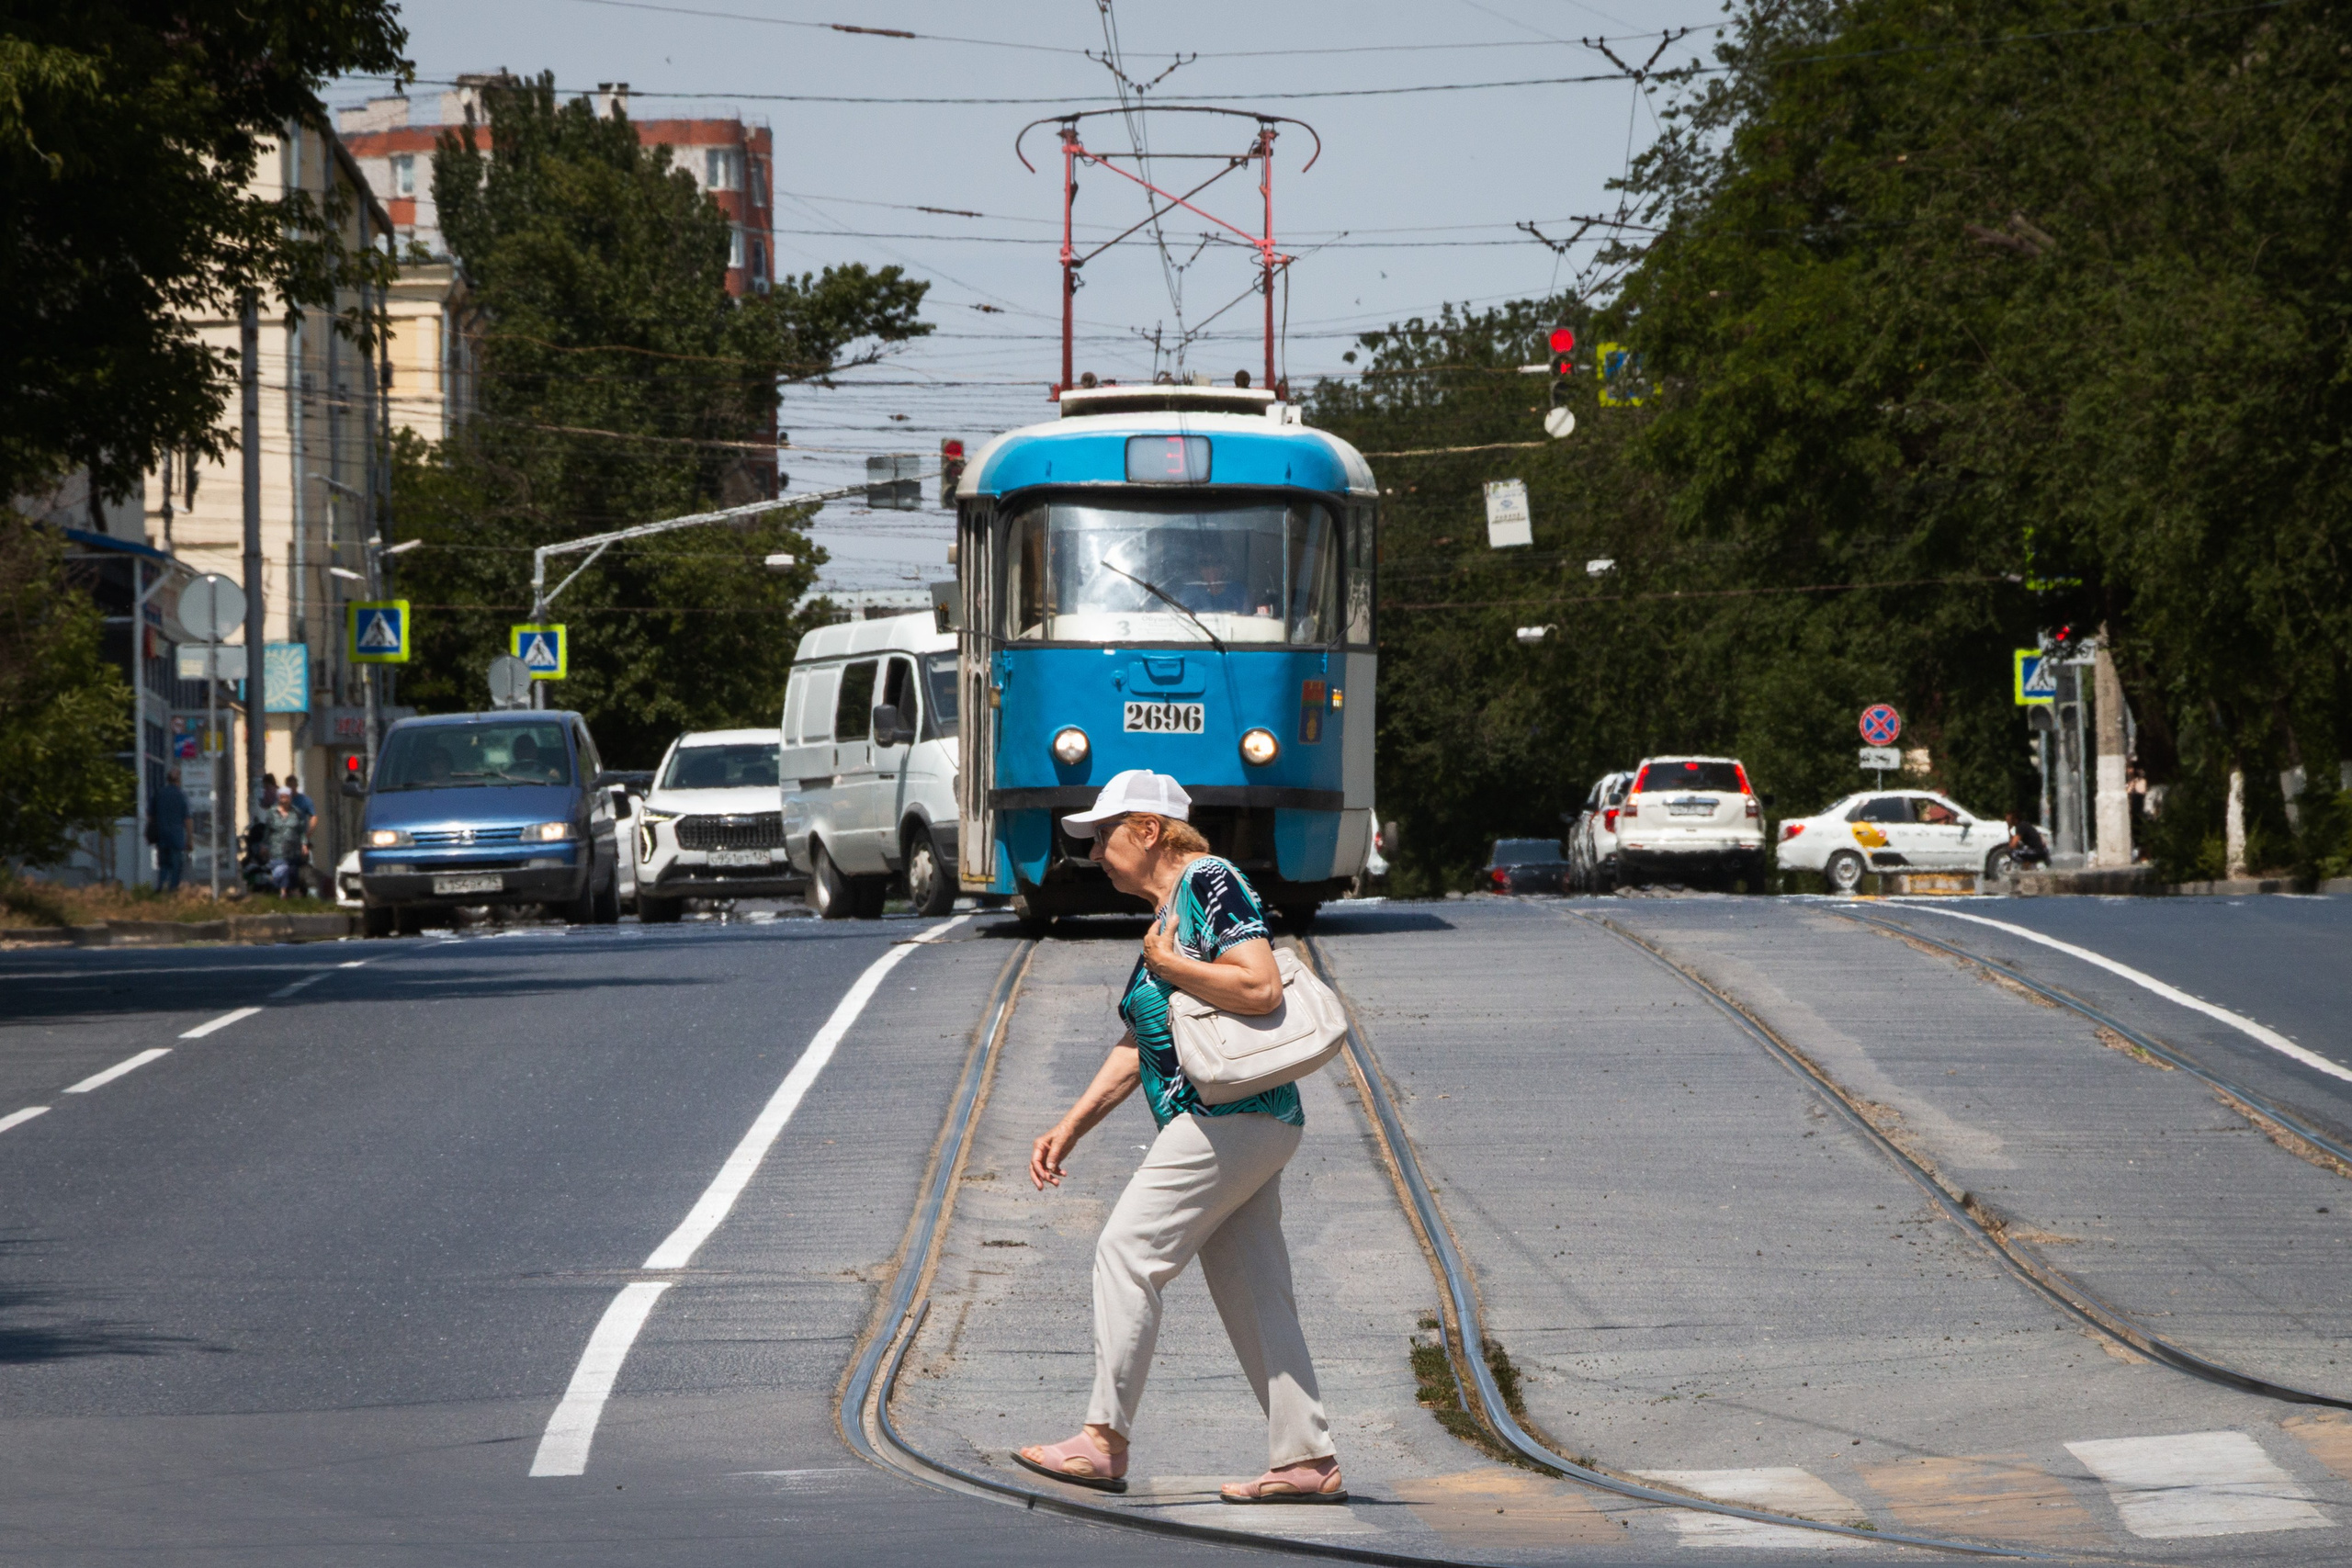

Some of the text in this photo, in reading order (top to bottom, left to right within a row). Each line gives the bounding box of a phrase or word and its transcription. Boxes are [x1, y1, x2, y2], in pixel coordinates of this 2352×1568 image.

[1166, 435, 1184, 473] 3
[1115, 619, 1131, 637] 3
[1126, 704, 1202, 732] 2696
